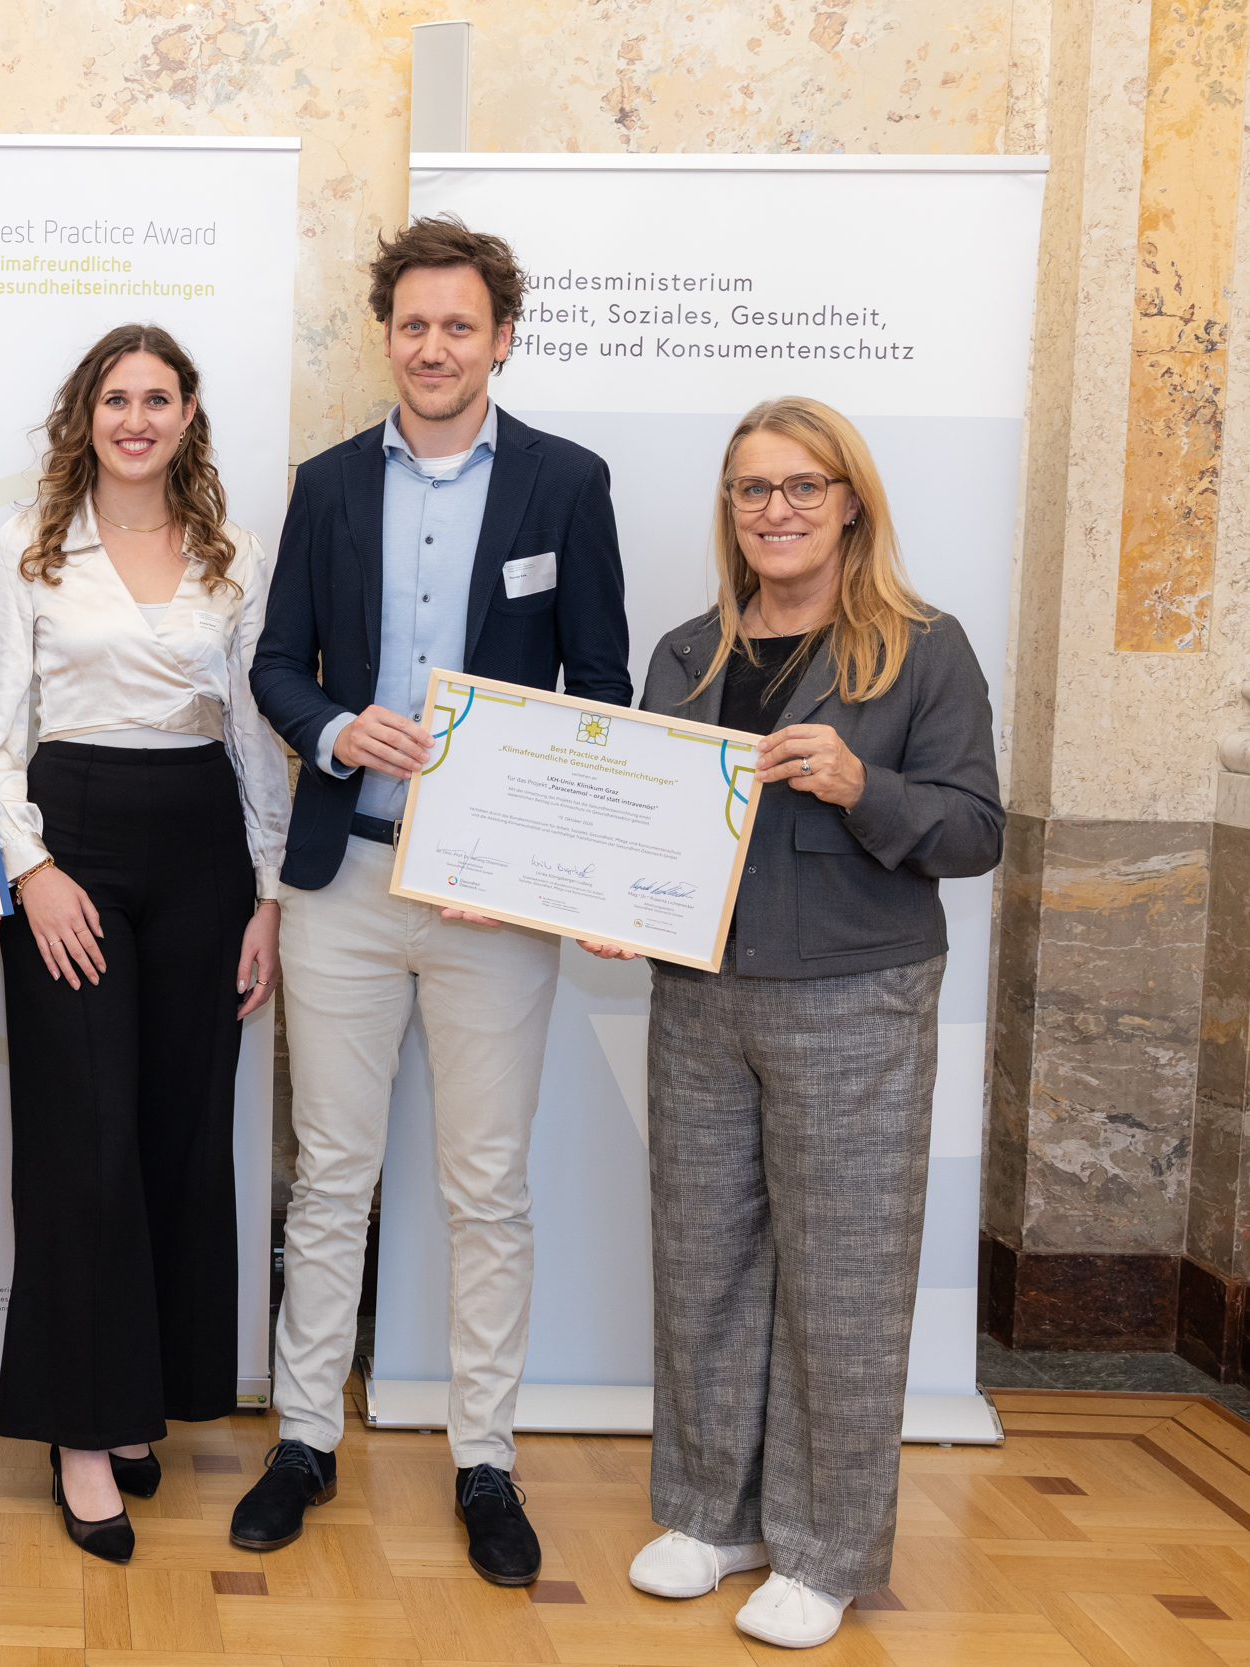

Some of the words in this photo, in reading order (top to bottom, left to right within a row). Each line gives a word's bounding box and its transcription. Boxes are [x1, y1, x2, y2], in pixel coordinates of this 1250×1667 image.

[43, 220, 135, 245] Practice
[142, 221, 217, 246] Award
[526, 268, 754, 293] undesministerium
[607, 303, 720, 329] Soziales,
[730, 304, 888, 331] Gesundheit,
[509, 334, 589, 362] Pflege
[599, 335, 644, 358] und
[656, 337, 915, 361] Konsumentenschutz
[498, 744, 569, 765] „Klimafreundliche
[569, 758, 679, 786] Gesundheitseinrichtungen“
[550, 744, 567, 755] Best
[568, 748, 599, 761] Practice
[600, 755, 628, 767] Award
[507, 774, 516, 782] für
[527, 778, 548, 789] Projekt
[548, 784, 589, 797] „Paracetamol
[606, 796, 621, 804] statt
[621, 798, 659, 811] intravenös!“
[546, 775, 576, 787] LKH-Univ.
[576, 781, 604, 792] Klinikum
[604, 787, 619, 796] Graz
